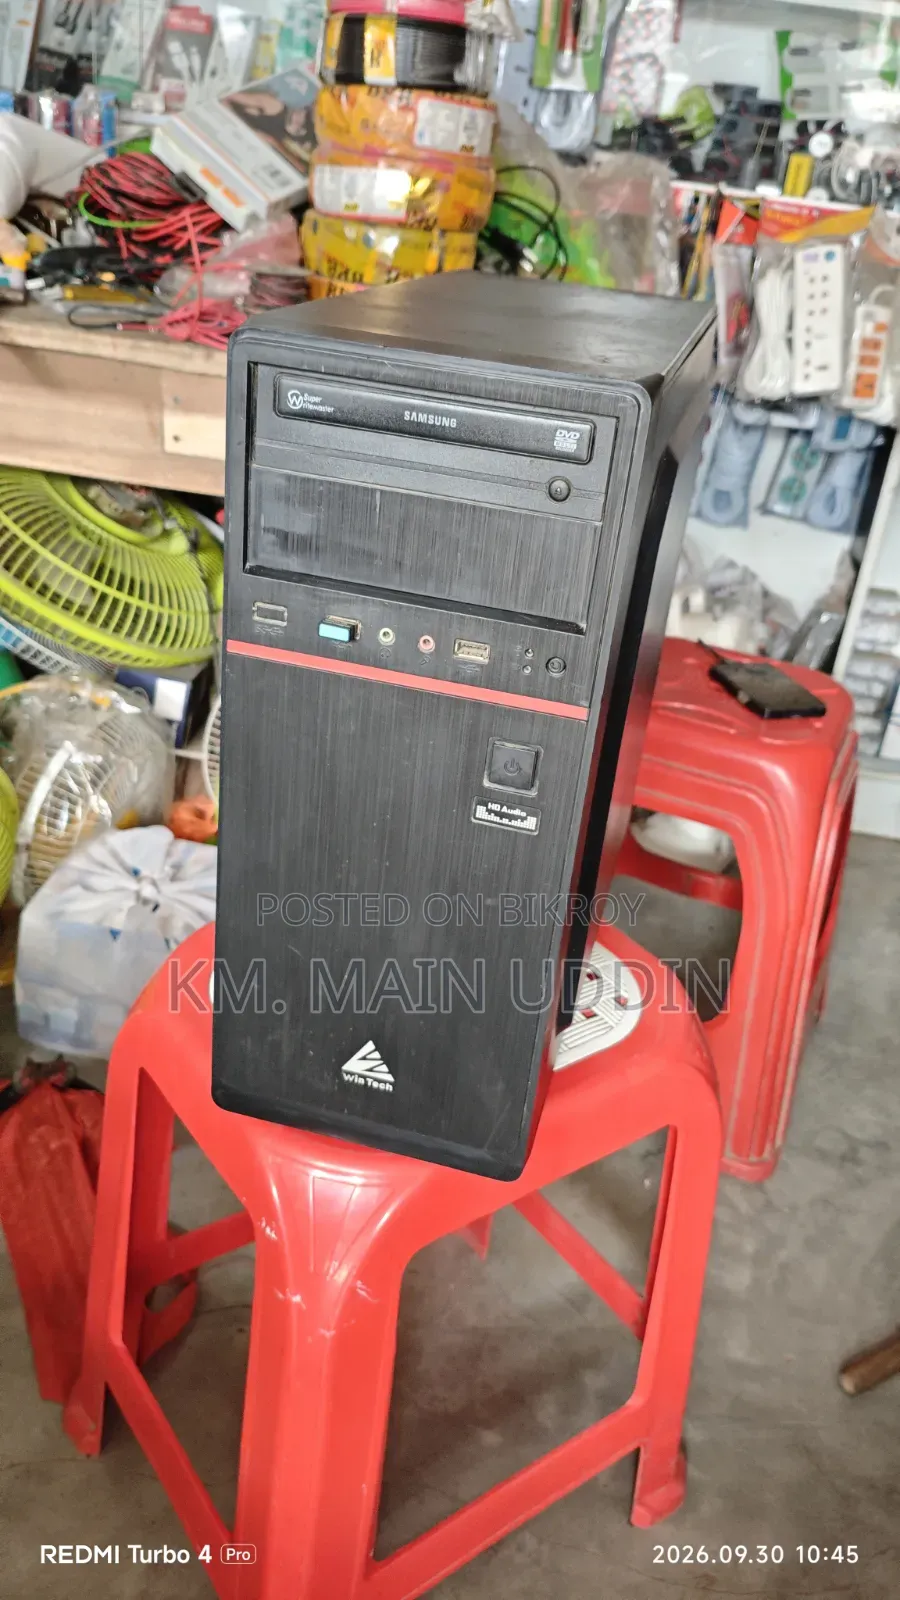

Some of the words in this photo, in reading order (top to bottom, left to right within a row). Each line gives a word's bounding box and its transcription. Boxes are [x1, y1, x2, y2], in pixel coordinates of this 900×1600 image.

[303, 392, 322, 403] Super
[404, 410, 457, 428] SAMSUNG
[555, 429, 580, 440] DVD
[487, 802, 501, 812] HD
[501, 805, 527, 817] Audio
